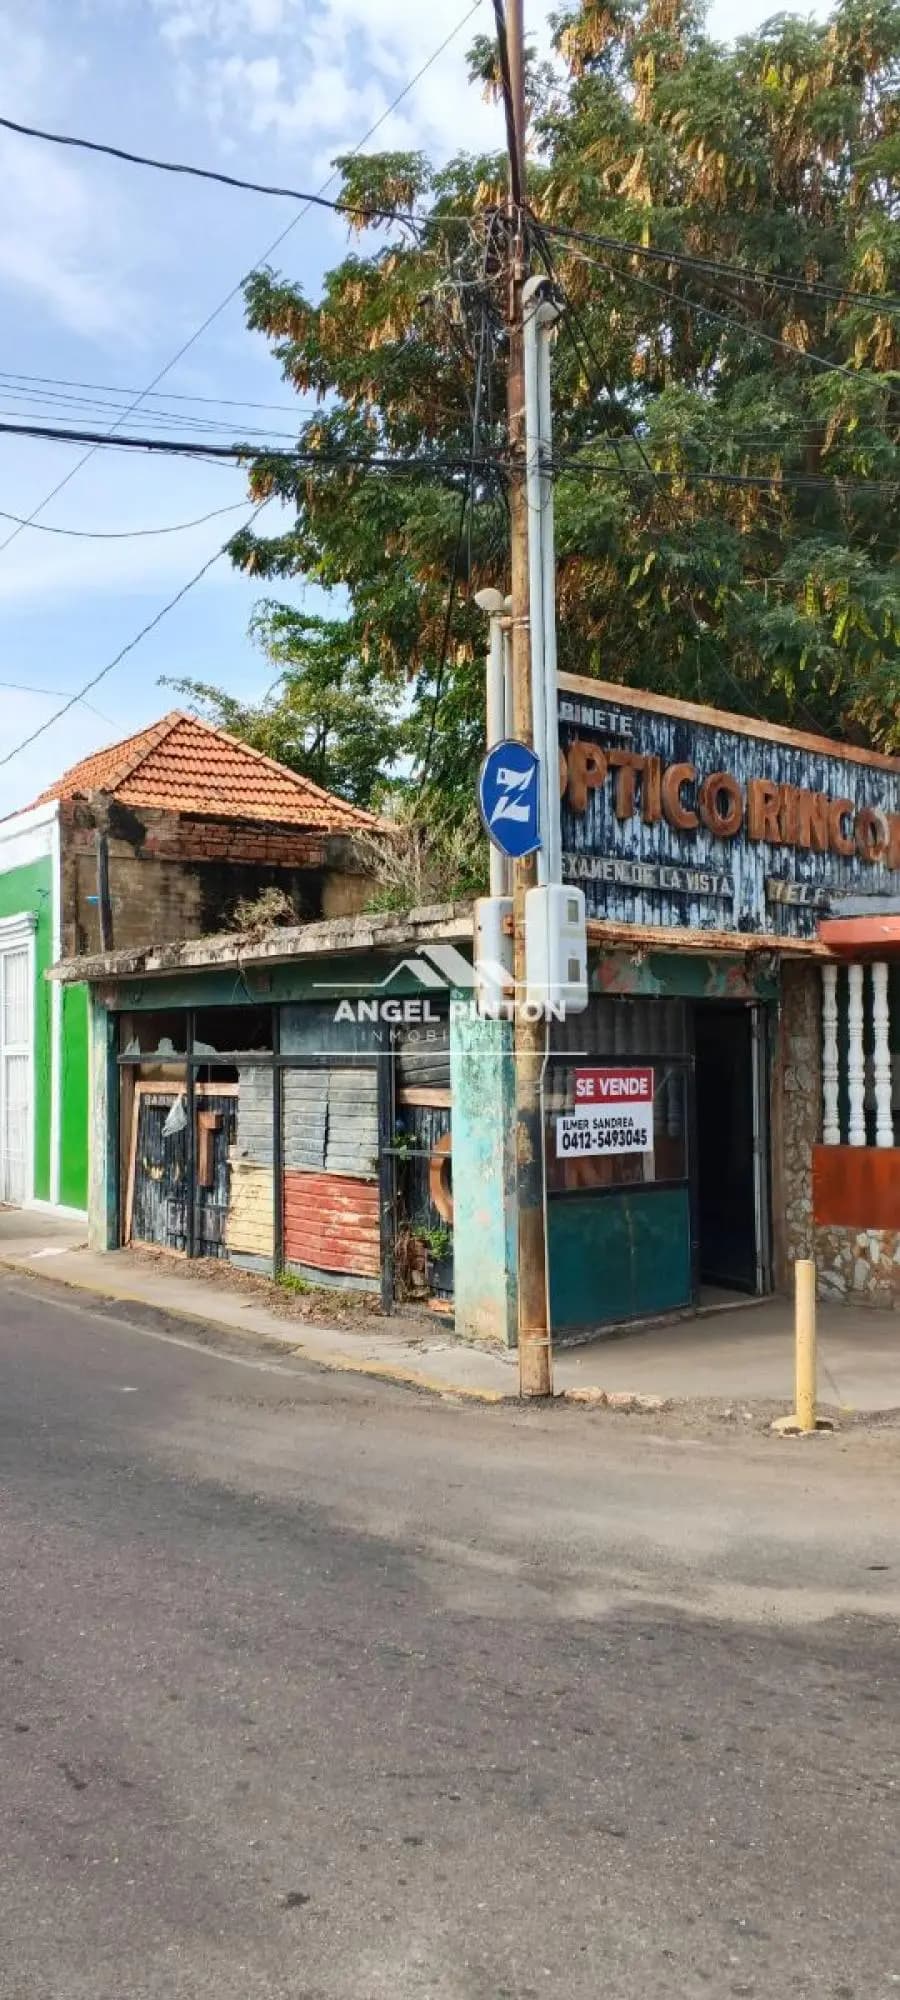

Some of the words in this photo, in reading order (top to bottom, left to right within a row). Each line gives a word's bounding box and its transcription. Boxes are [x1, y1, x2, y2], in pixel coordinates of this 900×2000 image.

[660, 867, 681, 889] LA
[687, 871, 733, 896] VISTA
[576, 1078, 594, 1096] SE
[599, 1077, 648, 1096] VENDE
[562, 1119, 589, 1130] ILMER
[592, 1117, 634, 1129] SANDREA
[562, 1129, 648, 1150] 0412-5493045
